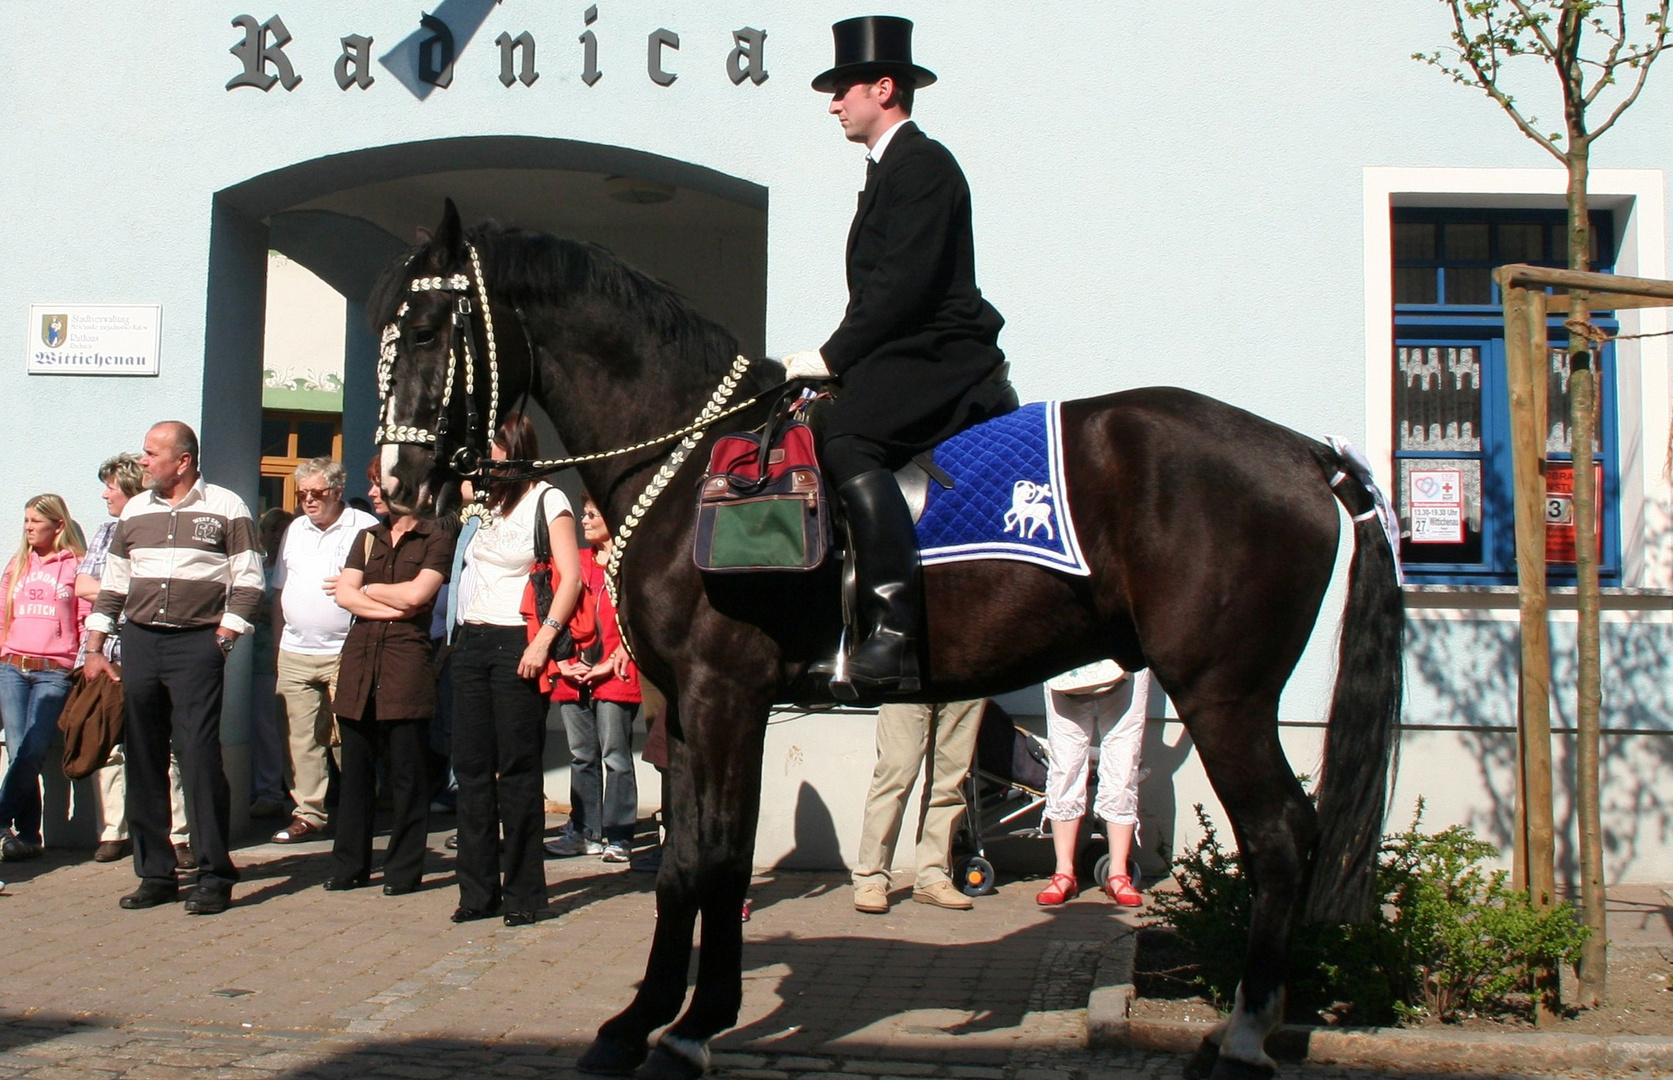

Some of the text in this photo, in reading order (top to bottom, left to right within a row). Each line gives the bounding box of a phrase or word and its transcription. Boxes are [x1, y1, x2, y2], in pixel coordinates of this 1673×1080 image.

[225, 4, 770, 92] Radnica
[35, 351, 147, 368] Wittichenau
[1548, 500, 1562, 518] 3
[192, 516, 210, 524] WEST
[29, 588, 44, 600] 92
[27, 603, 56, 616] FITCH
